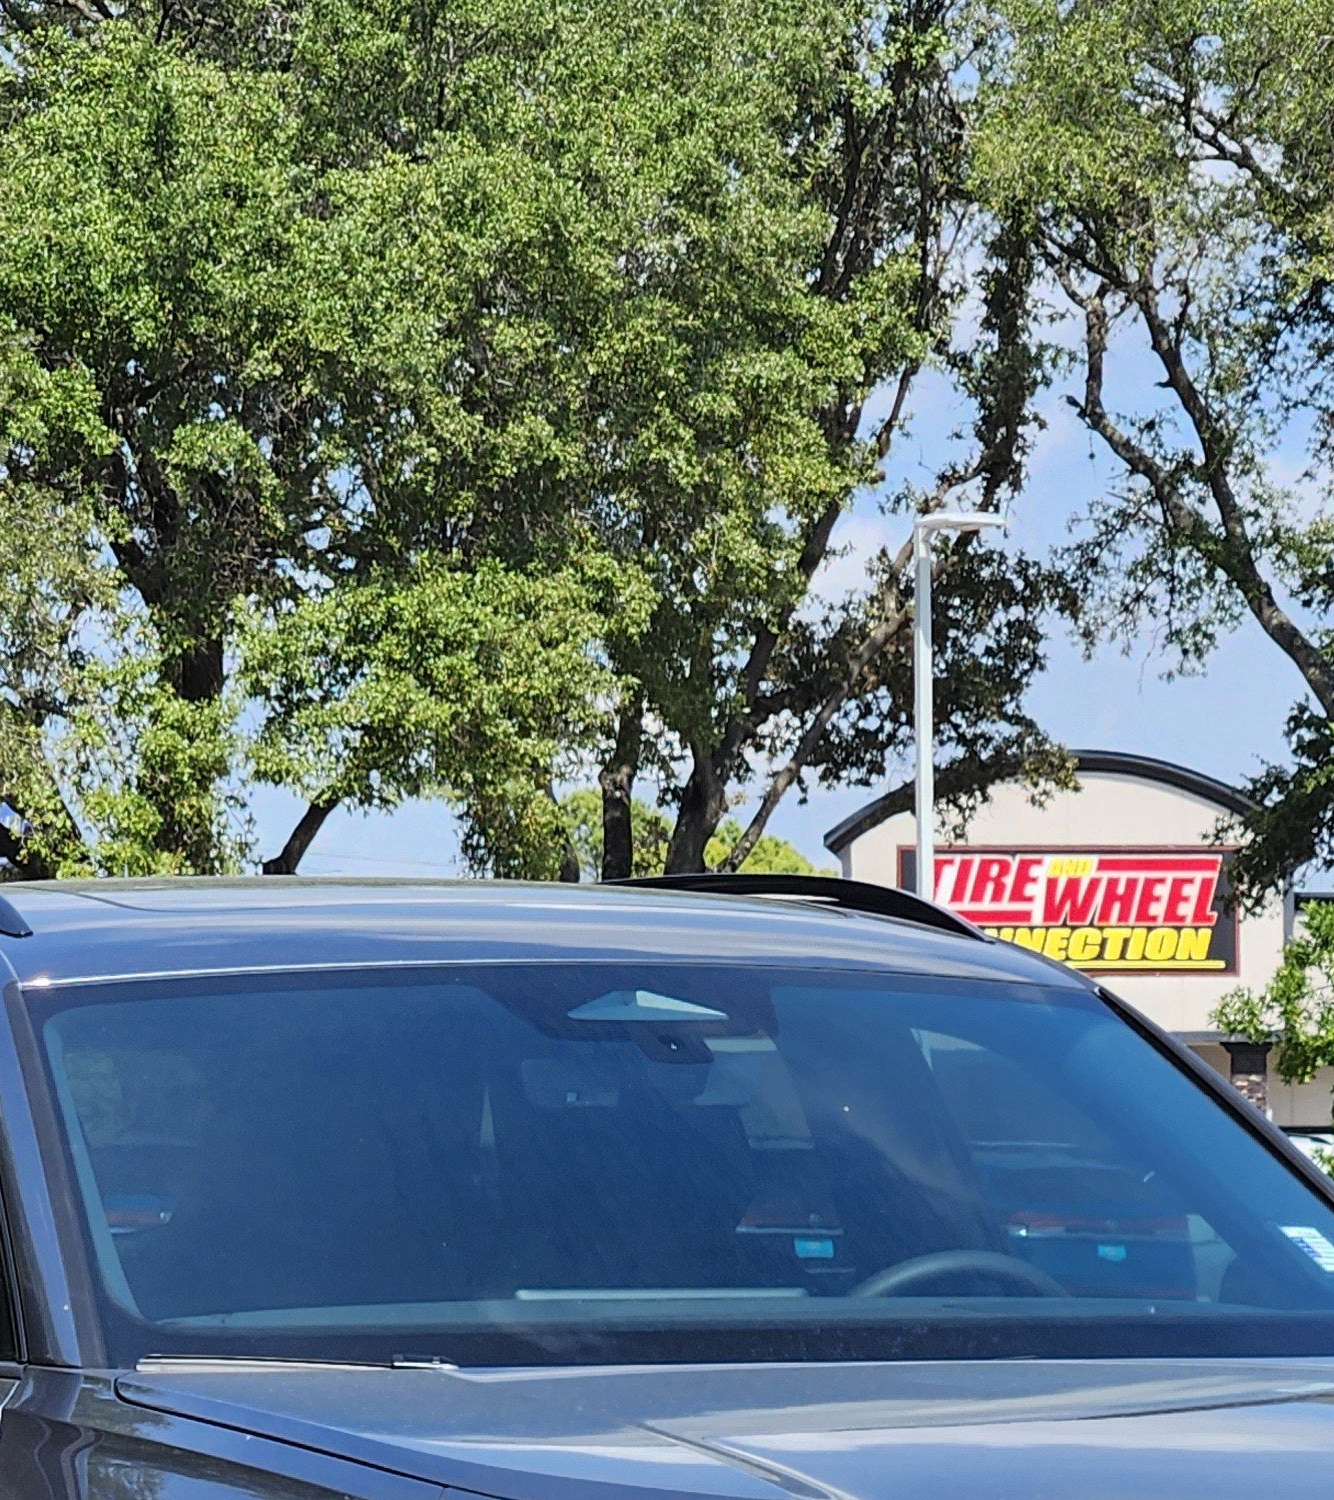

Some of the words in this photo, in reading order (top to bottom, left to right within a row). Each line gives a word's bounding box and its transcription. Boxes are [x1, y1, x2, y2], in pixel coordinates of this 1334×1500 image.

[1048, 857, 1092, 876] AND
[1042, 877, 1216, 923] WHEEL
[983, 927, 1213, 961] NECTION
